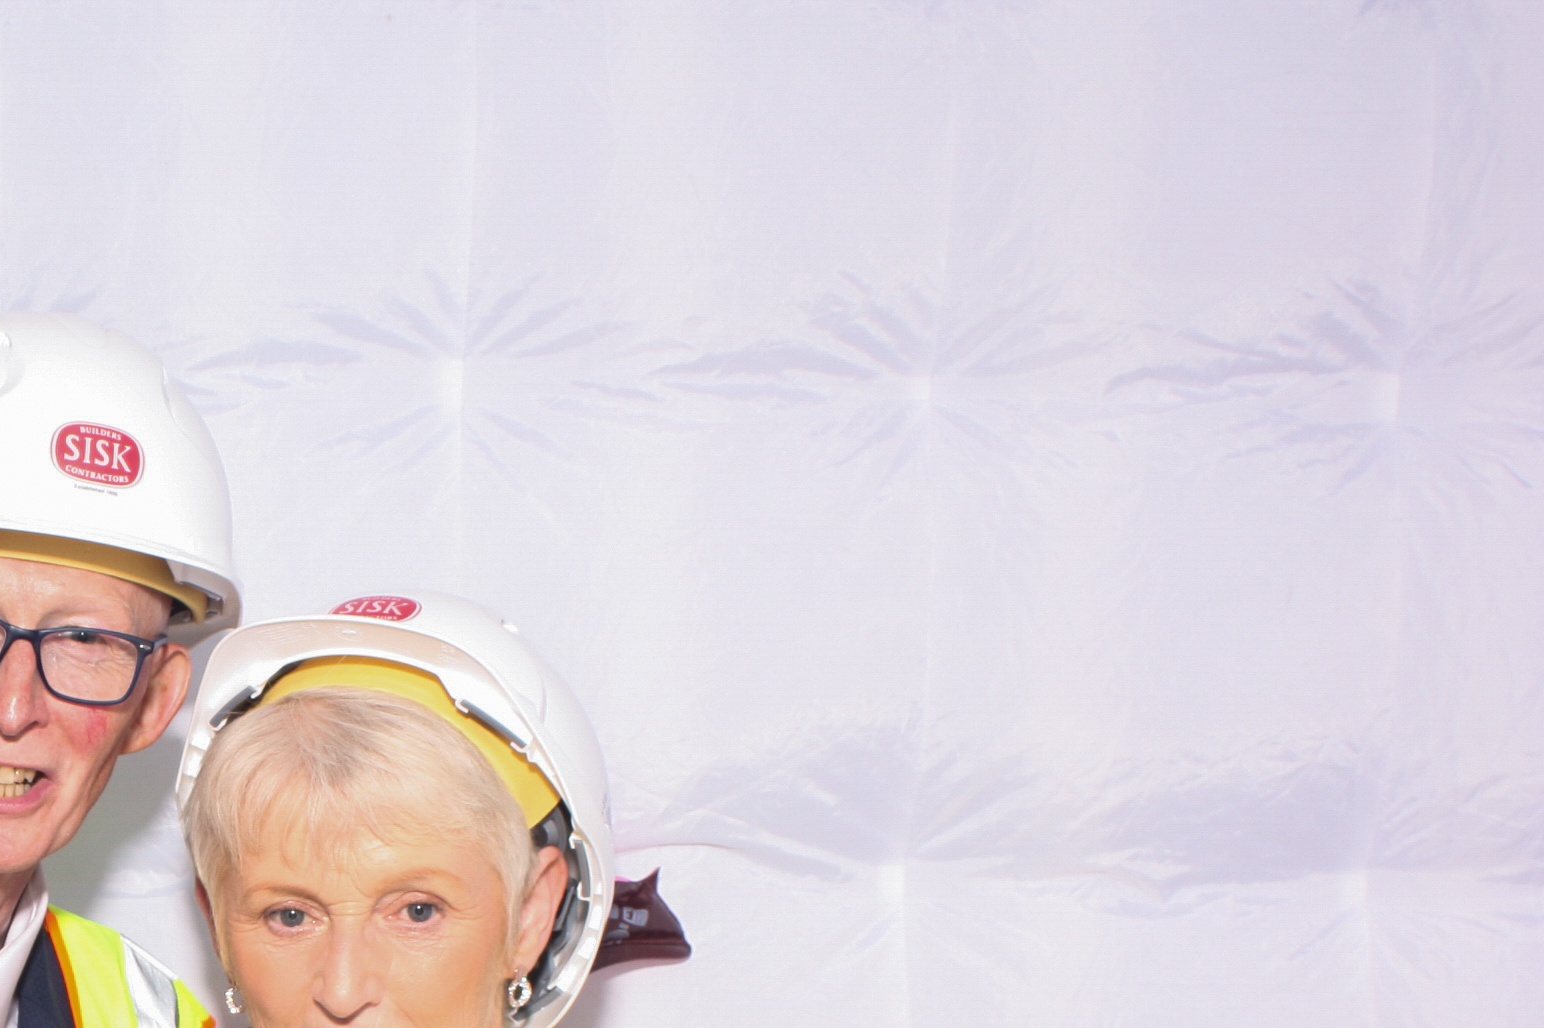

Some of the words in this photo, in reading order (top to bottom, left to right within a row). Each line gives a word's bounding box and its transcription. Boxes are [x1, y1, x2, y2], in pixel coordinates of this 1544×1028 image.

[79, 425, 122, 441] BUILDERS
[64, 434, 131, 473] SISK
[65, 464, 129, 483] CONTRACTORS
[339, 600, 408, 615] SISK
